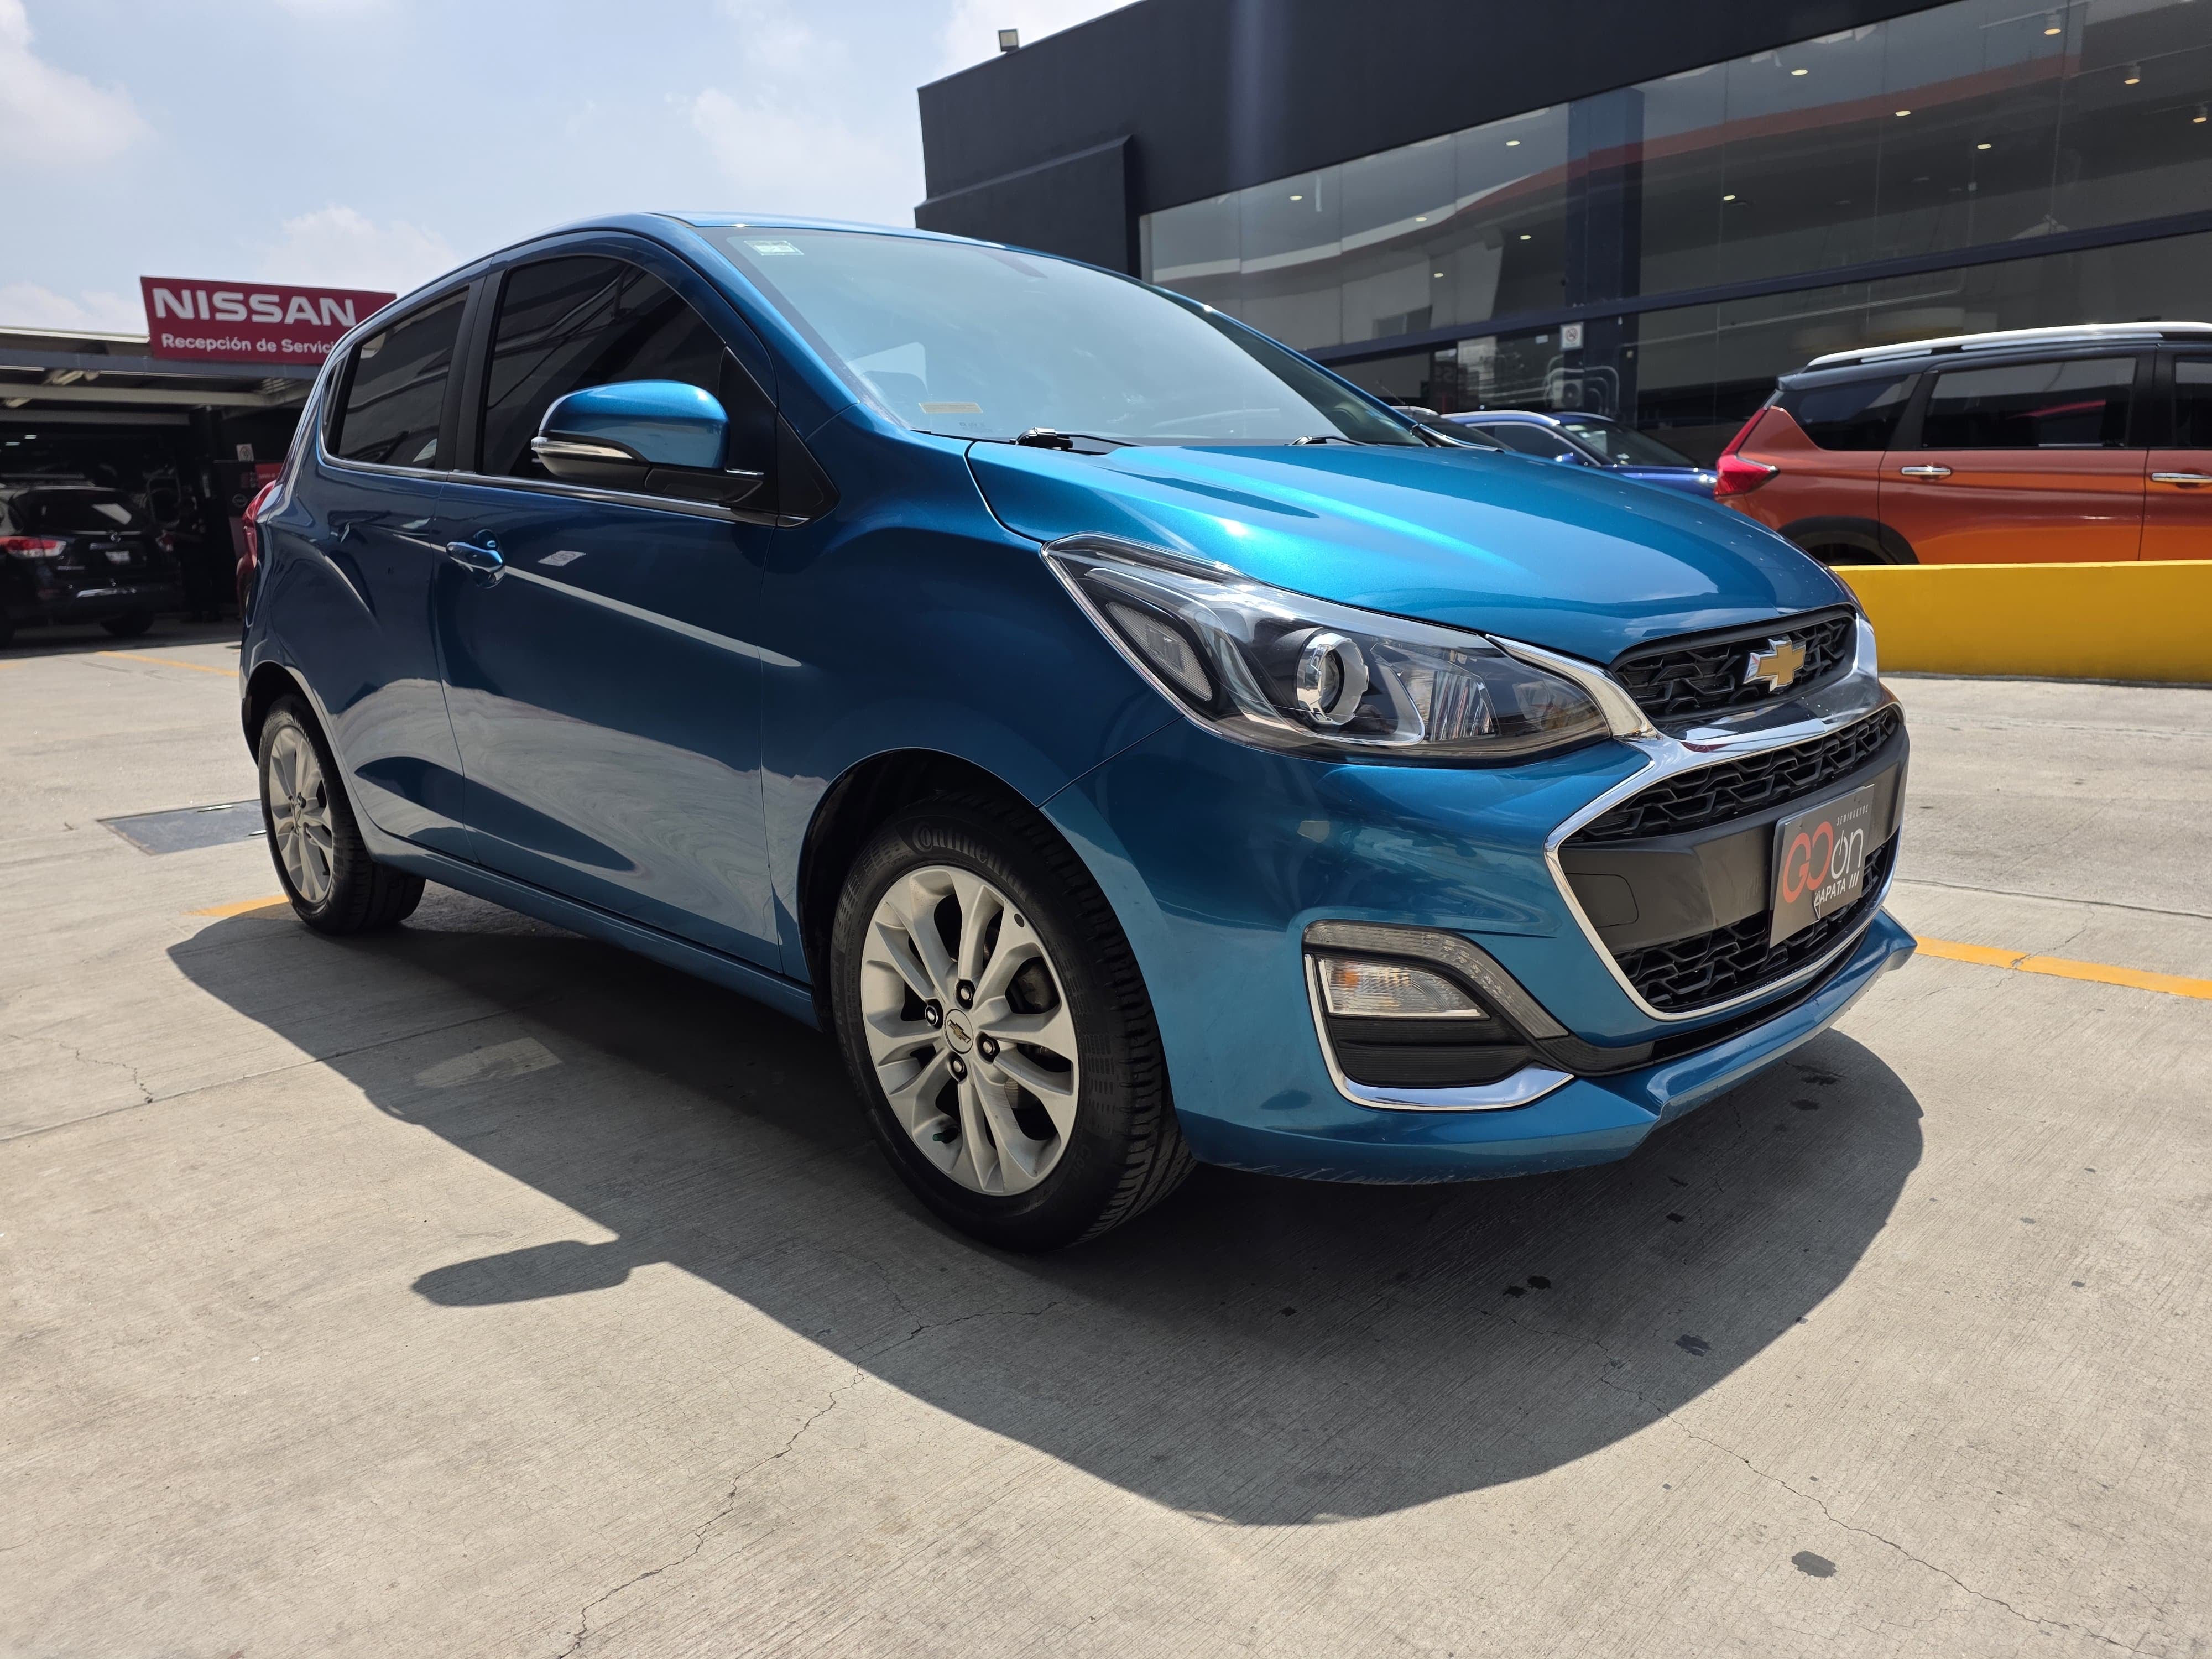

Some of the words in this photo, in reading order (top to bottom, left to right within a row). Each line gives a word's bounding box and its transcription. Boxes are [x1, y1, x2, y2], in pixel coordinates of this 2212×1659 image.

[153, 287, 357, 327] NISSAN
[161, 333, 252, 352] Recepción
[255, 338, 277, 353] de
[281, 338, 335, 354] Servici
[1837, 804, 1869, 826] SEMINUEVOS
[912, 822, 1027, 902] Continental
[1814, 878, 1846, 907] ZAPATA
